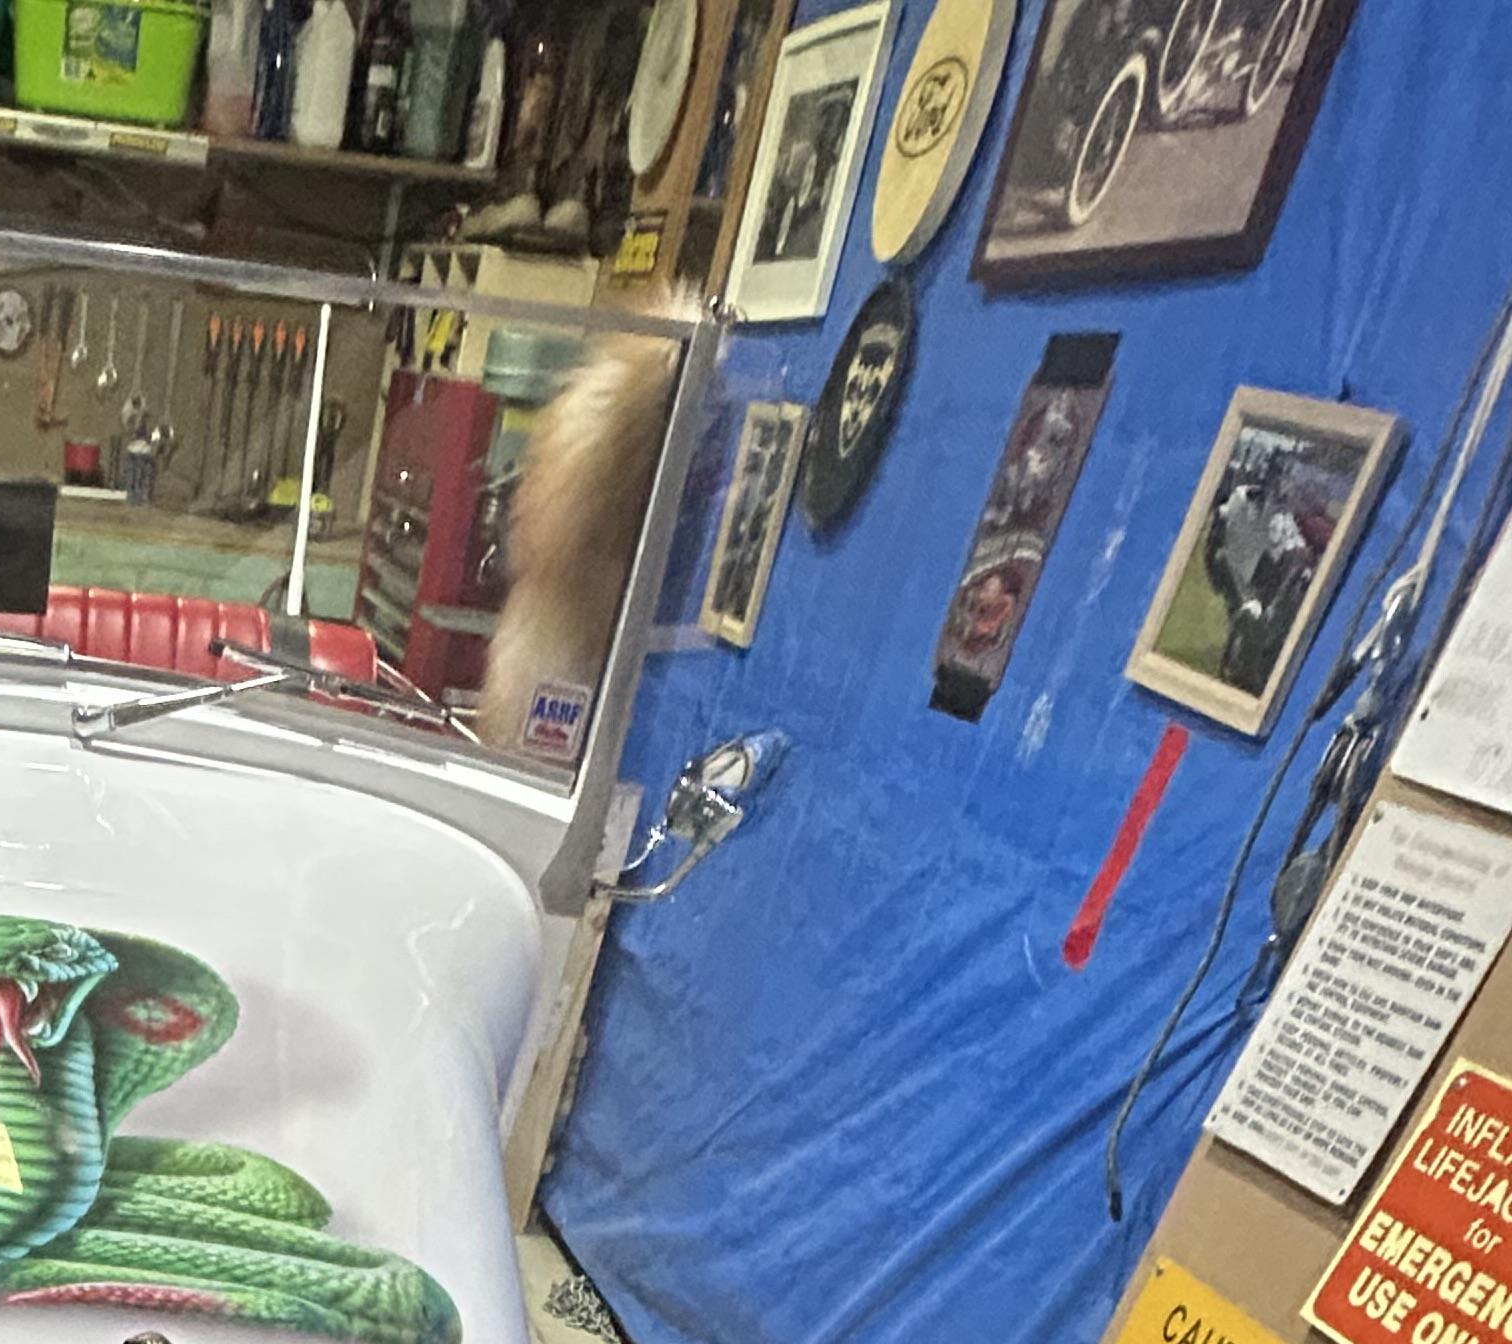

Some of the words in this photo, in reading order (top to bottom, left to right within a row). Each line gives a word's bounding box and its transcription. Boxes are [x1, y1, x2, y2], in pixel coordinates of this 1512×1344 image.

[1445, 1103, 1512, 1166] INFL
[1463, 1217, 1503, 1254] for
[1348, 1266, 1417, 1334] USE
[1358, 1209, 1512, 1342] EMERGEN
